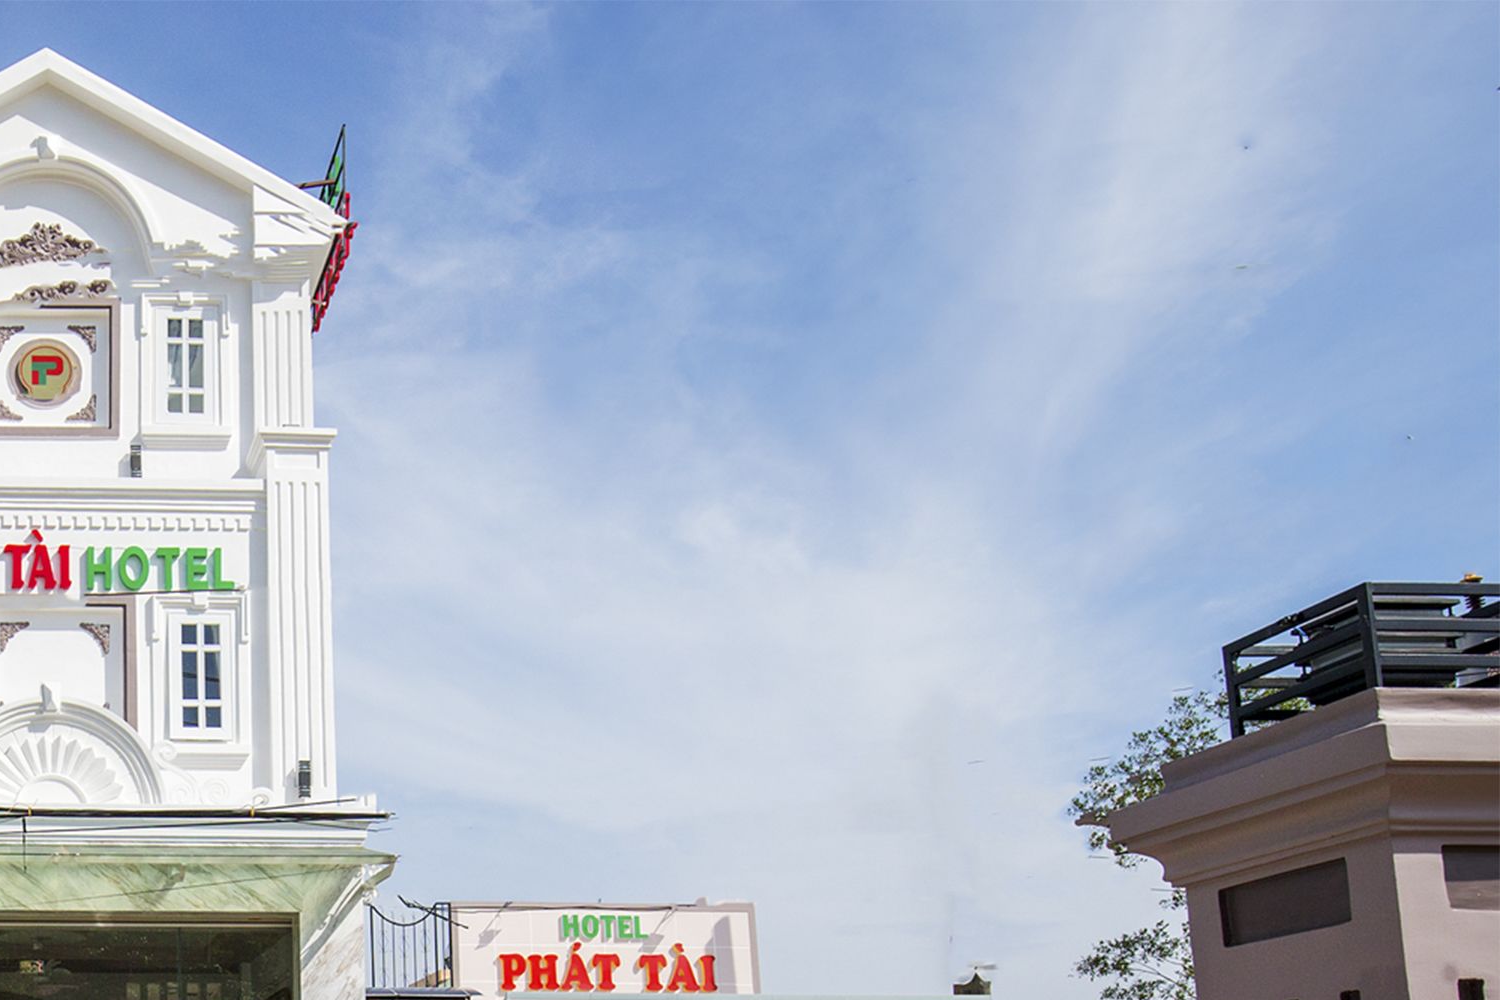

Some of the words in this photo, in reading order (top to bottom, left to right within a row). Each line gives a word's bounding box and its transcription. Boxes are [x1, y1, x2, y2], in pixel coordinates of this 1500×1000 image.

[3, 529, 73, 591] TÀI
[85, 545, 236, 592] HOTEL
[561, 914, 649, 939] HOTEL
[499, 942, 621, 992] PHÁT
[638, 943, 718, 992] TÀI
